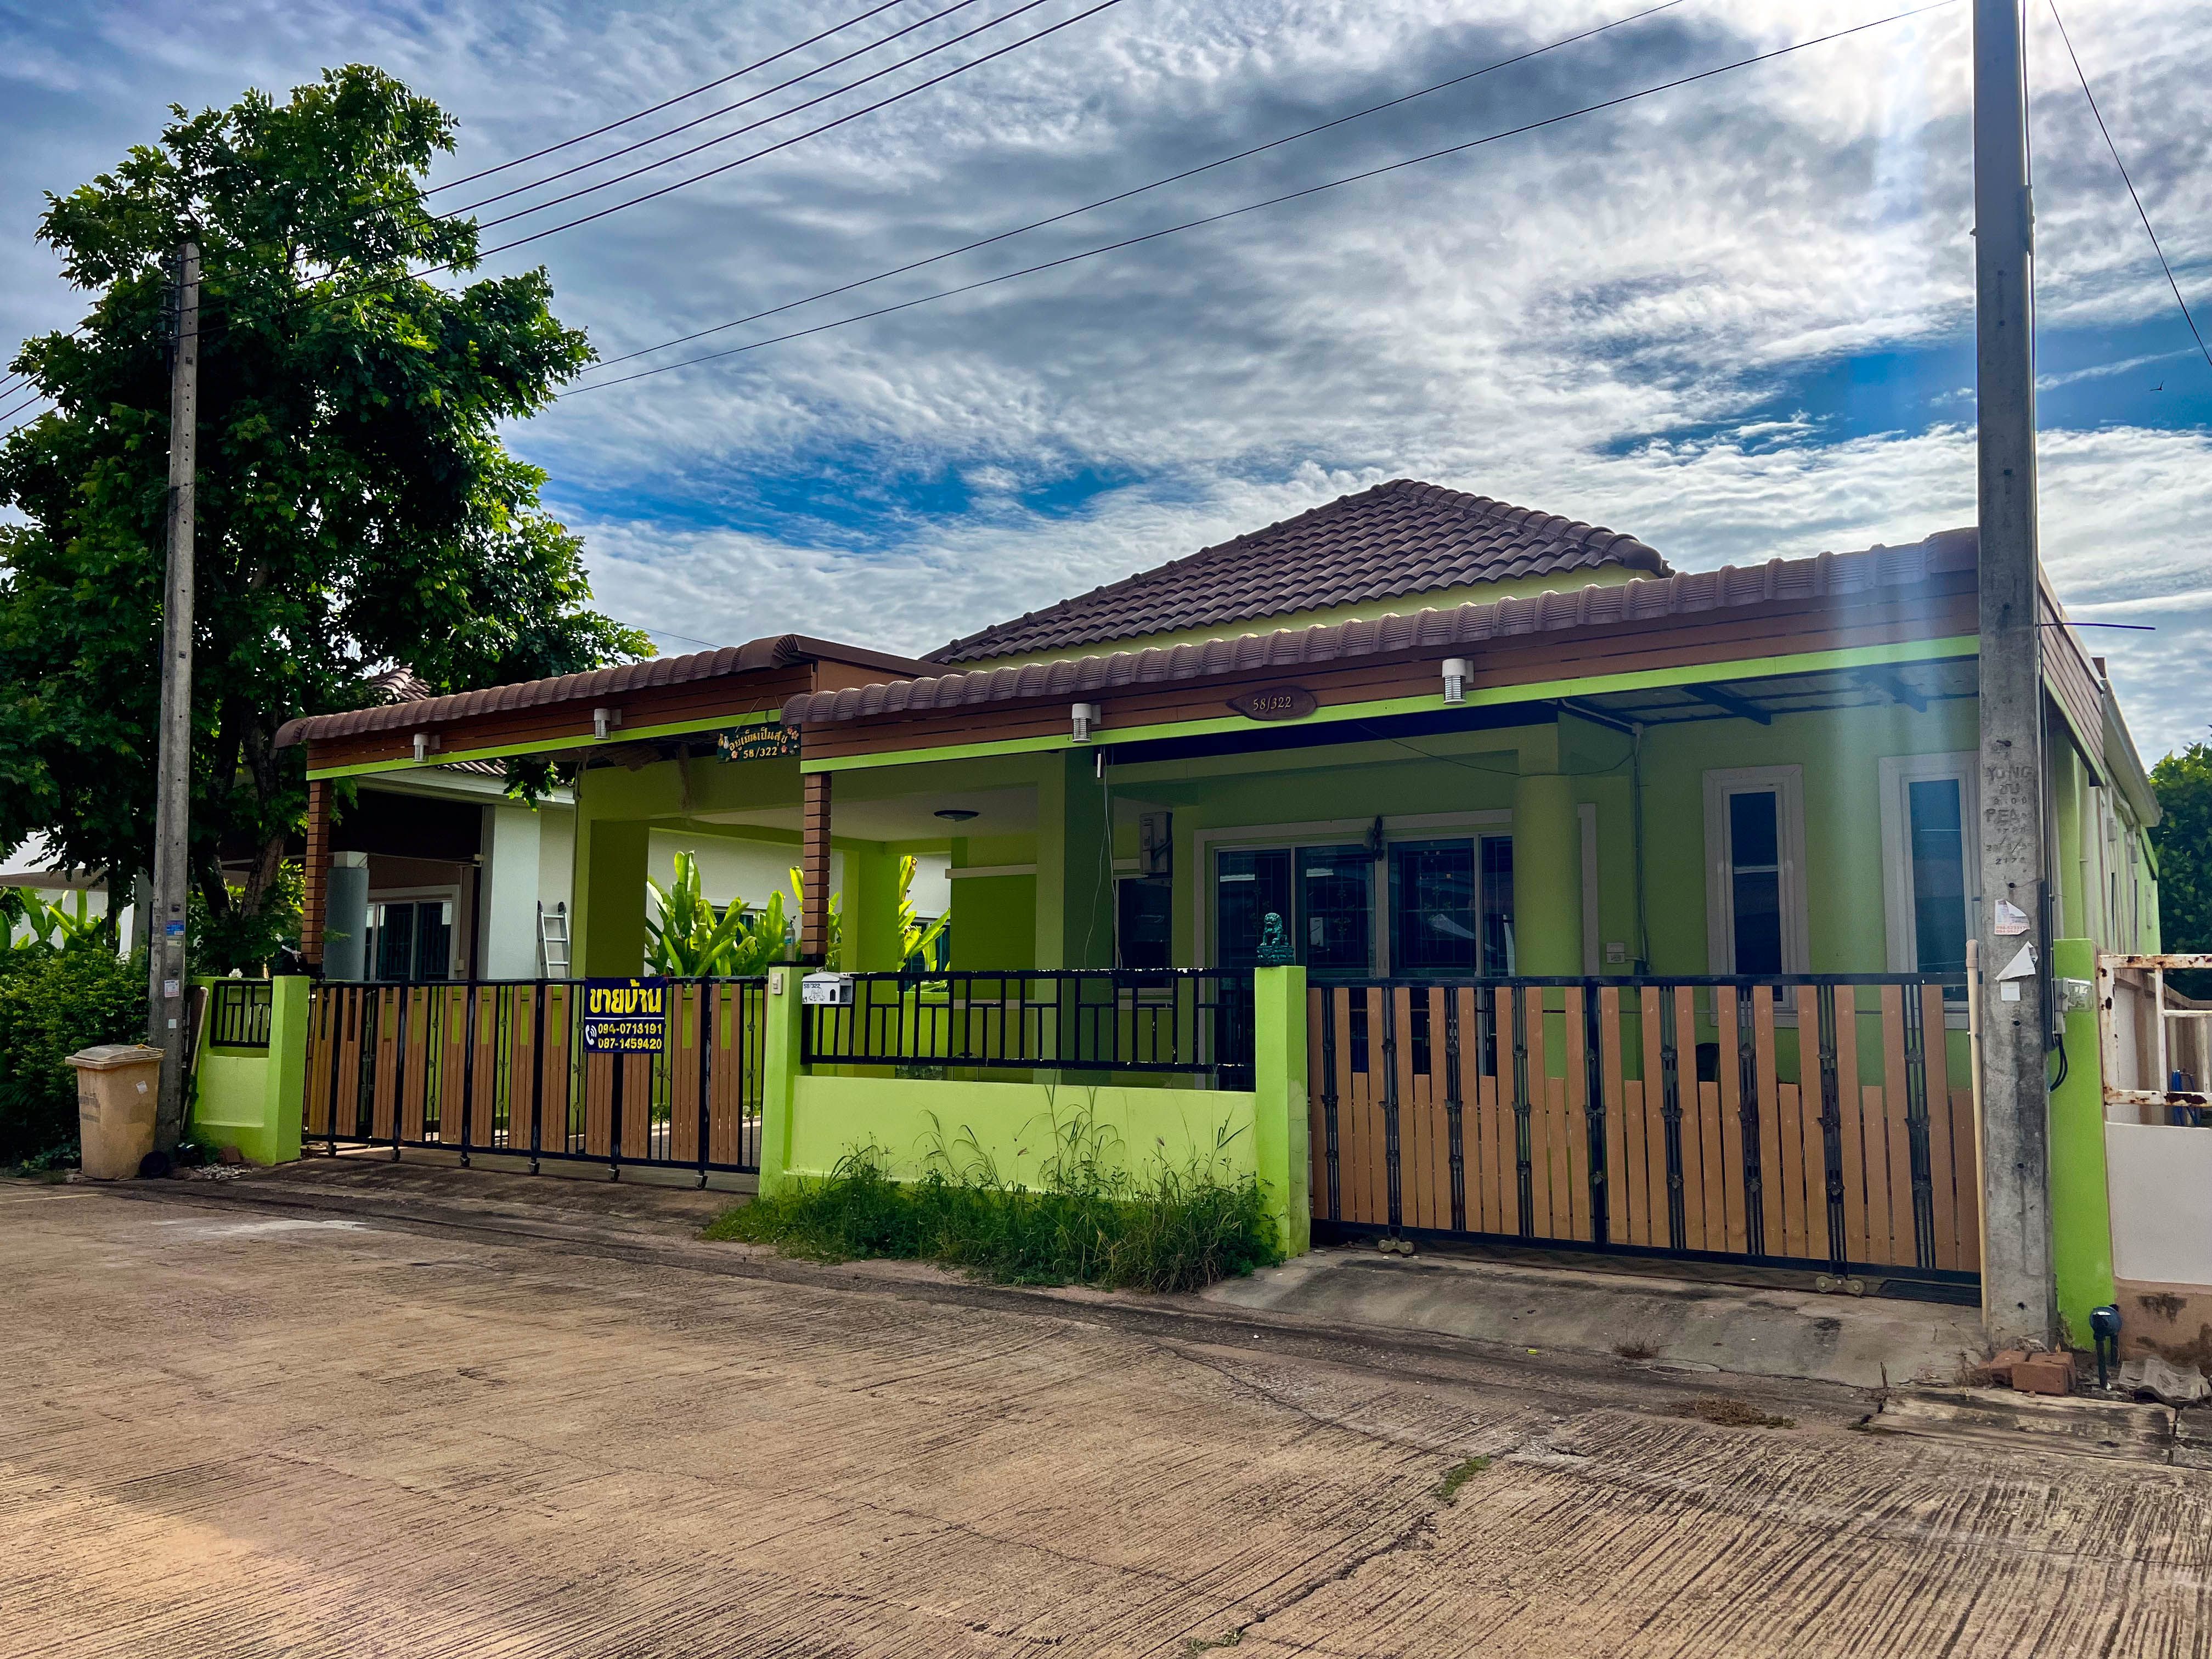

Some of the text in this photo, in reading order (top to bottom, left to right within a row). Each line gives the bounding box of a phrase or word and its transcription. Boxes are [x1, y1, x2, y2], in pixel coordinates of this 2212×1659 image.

[1253, 695, 1291, 713] 58/322
[743, 747, 777, 759] 58/322
[590, 979, 662, 1013] ขายบ้าน
[597, 1023, 662, 1034] 094-0713191
[597, 1037, 663, 1049] 087-1459420
